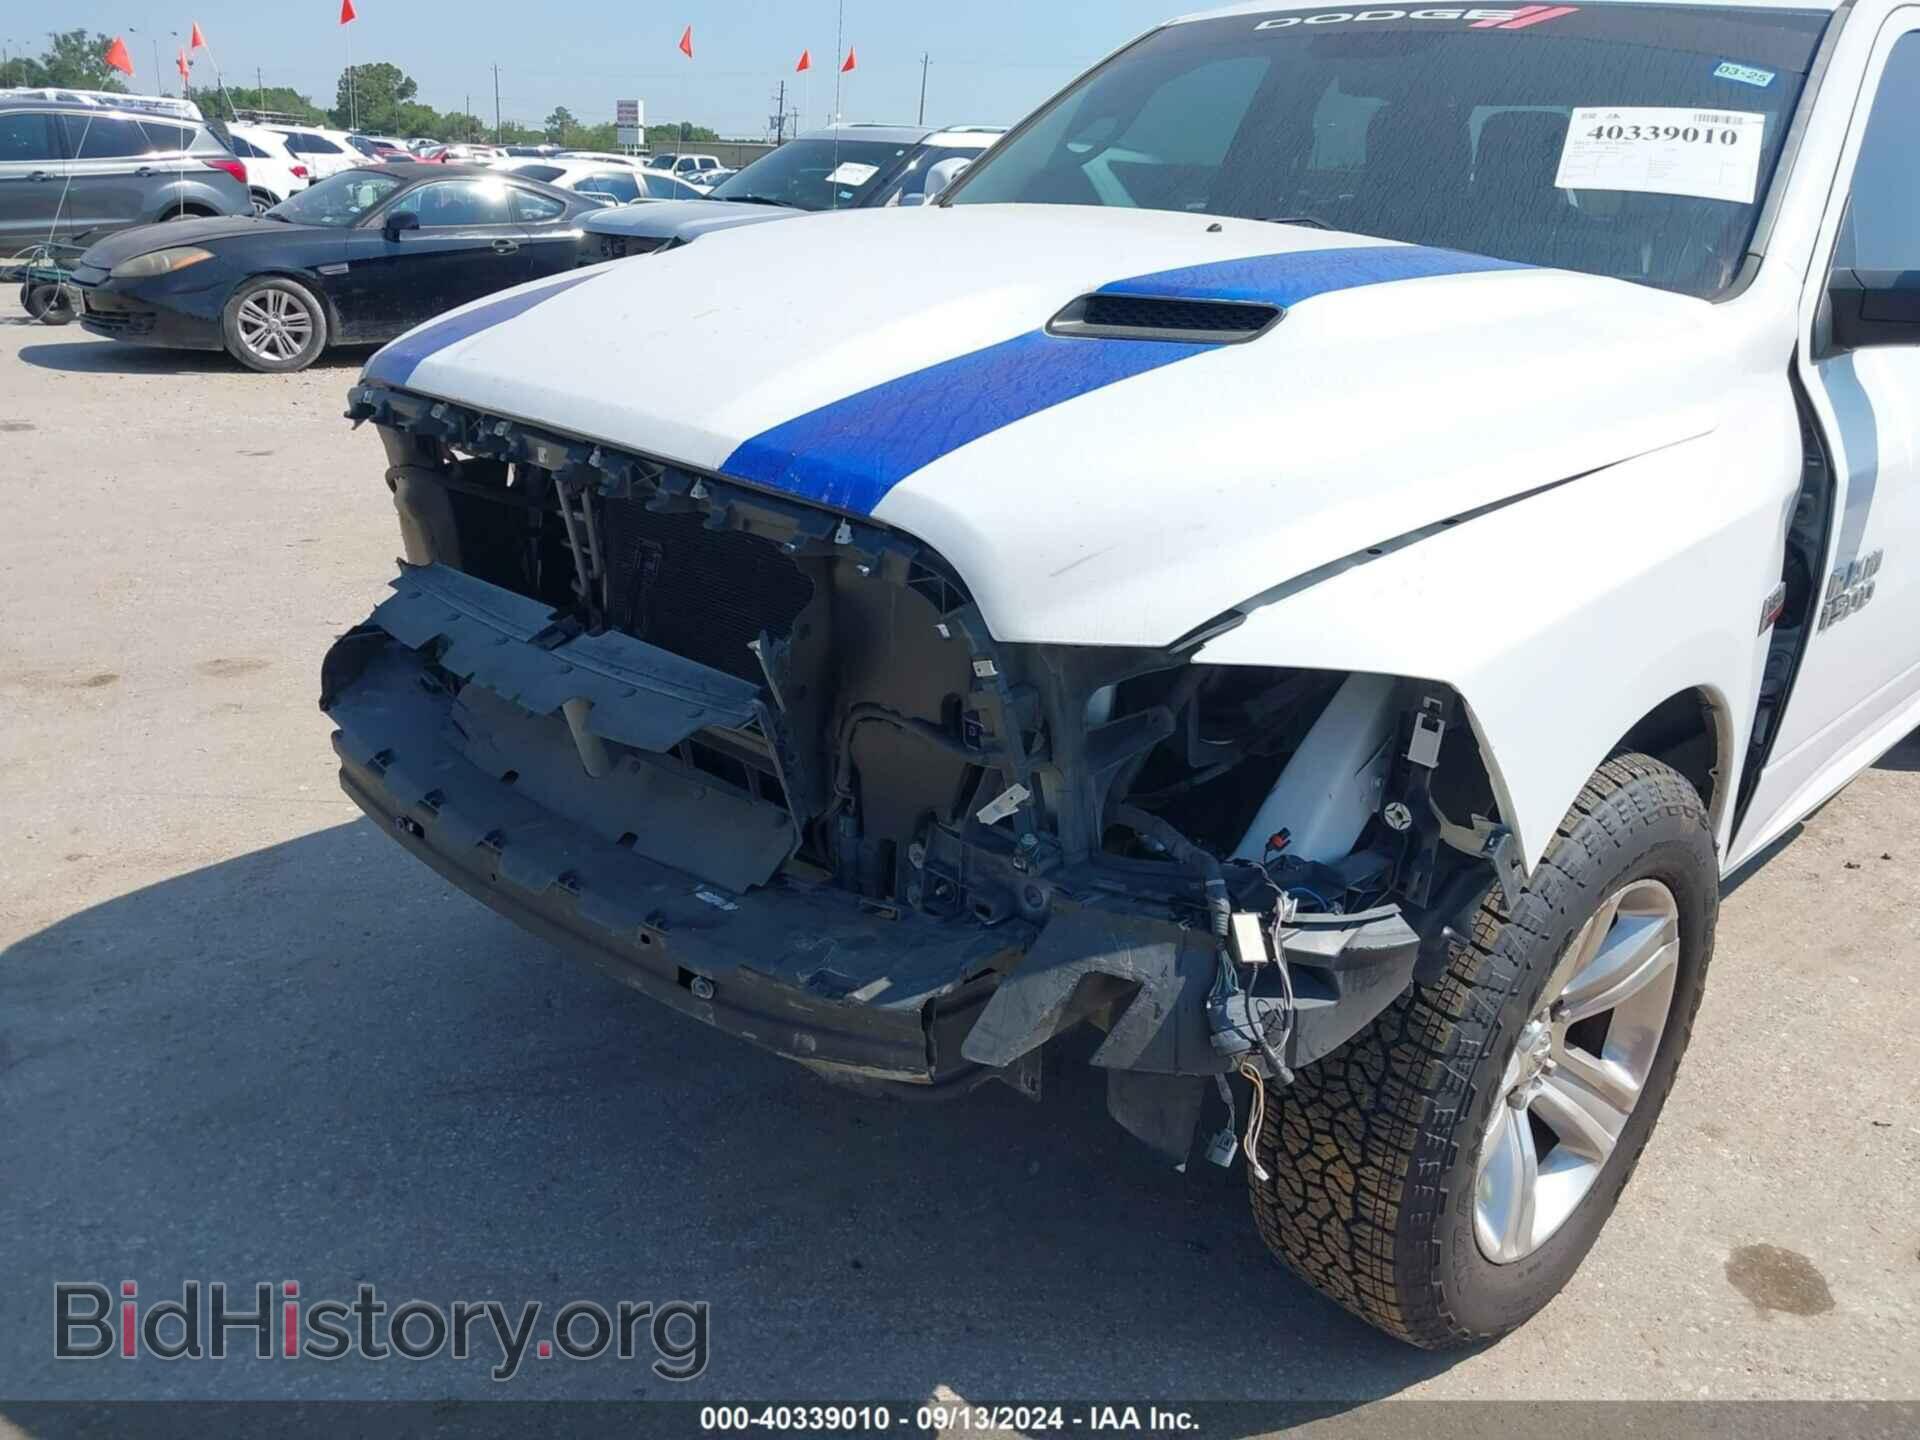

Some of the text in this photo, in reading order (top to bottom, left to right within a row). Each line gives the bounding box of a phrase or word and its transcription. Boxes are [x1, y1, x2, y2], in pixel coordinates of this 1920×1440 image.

[1254, 9, 1514, 31] DODGE
[1719, 65, 1769, 82] 03-25
[1587, 125, 1737, 145] 40339010
